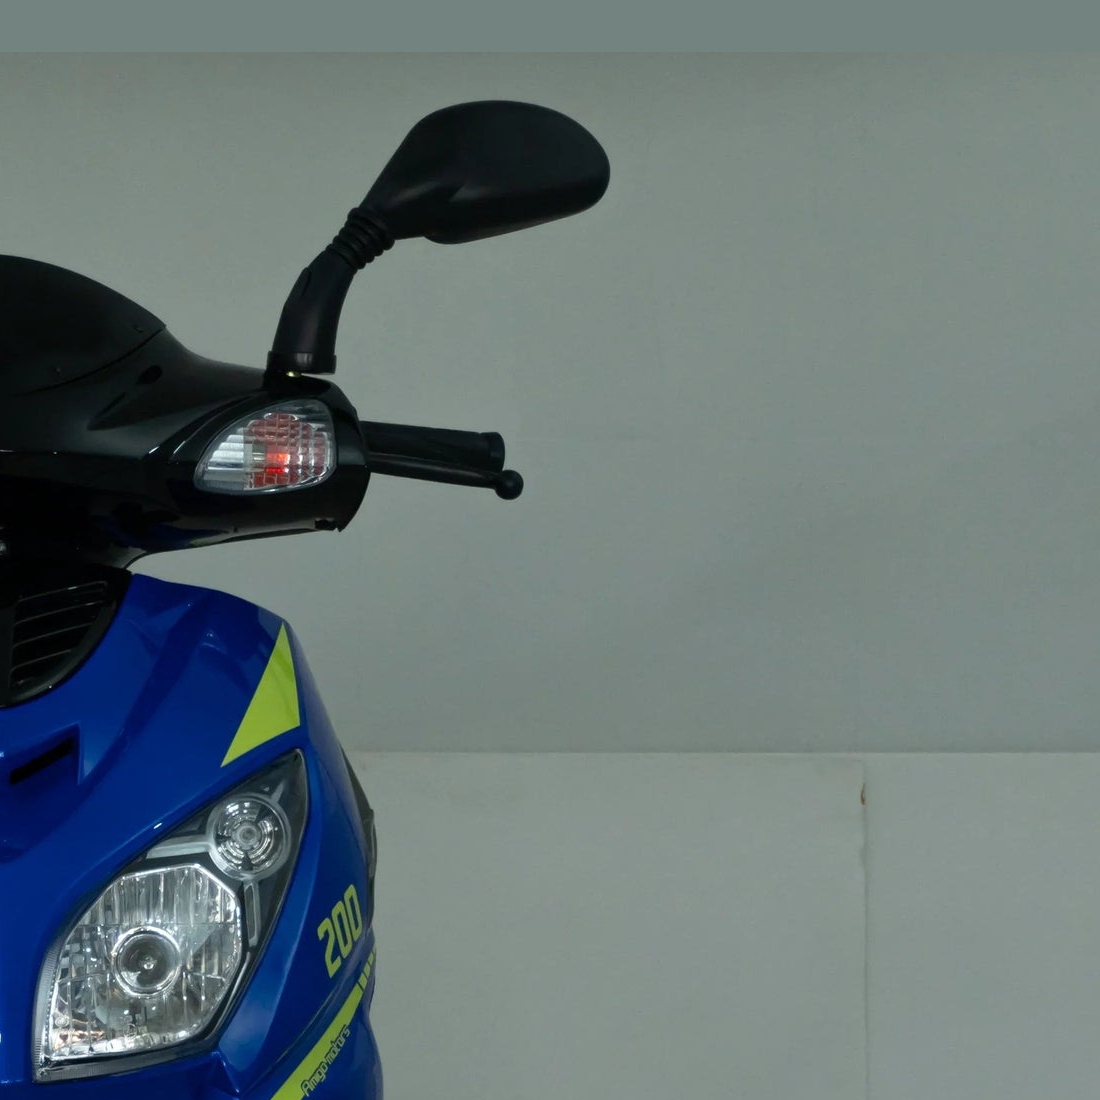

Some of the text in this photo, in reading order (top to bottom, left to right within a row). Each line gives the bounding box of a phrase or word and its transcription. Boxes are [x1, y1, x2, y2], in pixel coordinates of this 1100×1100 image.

[317, 884, 363, 979] 200
[301, 1024, 351, 1097] Amigo motors
